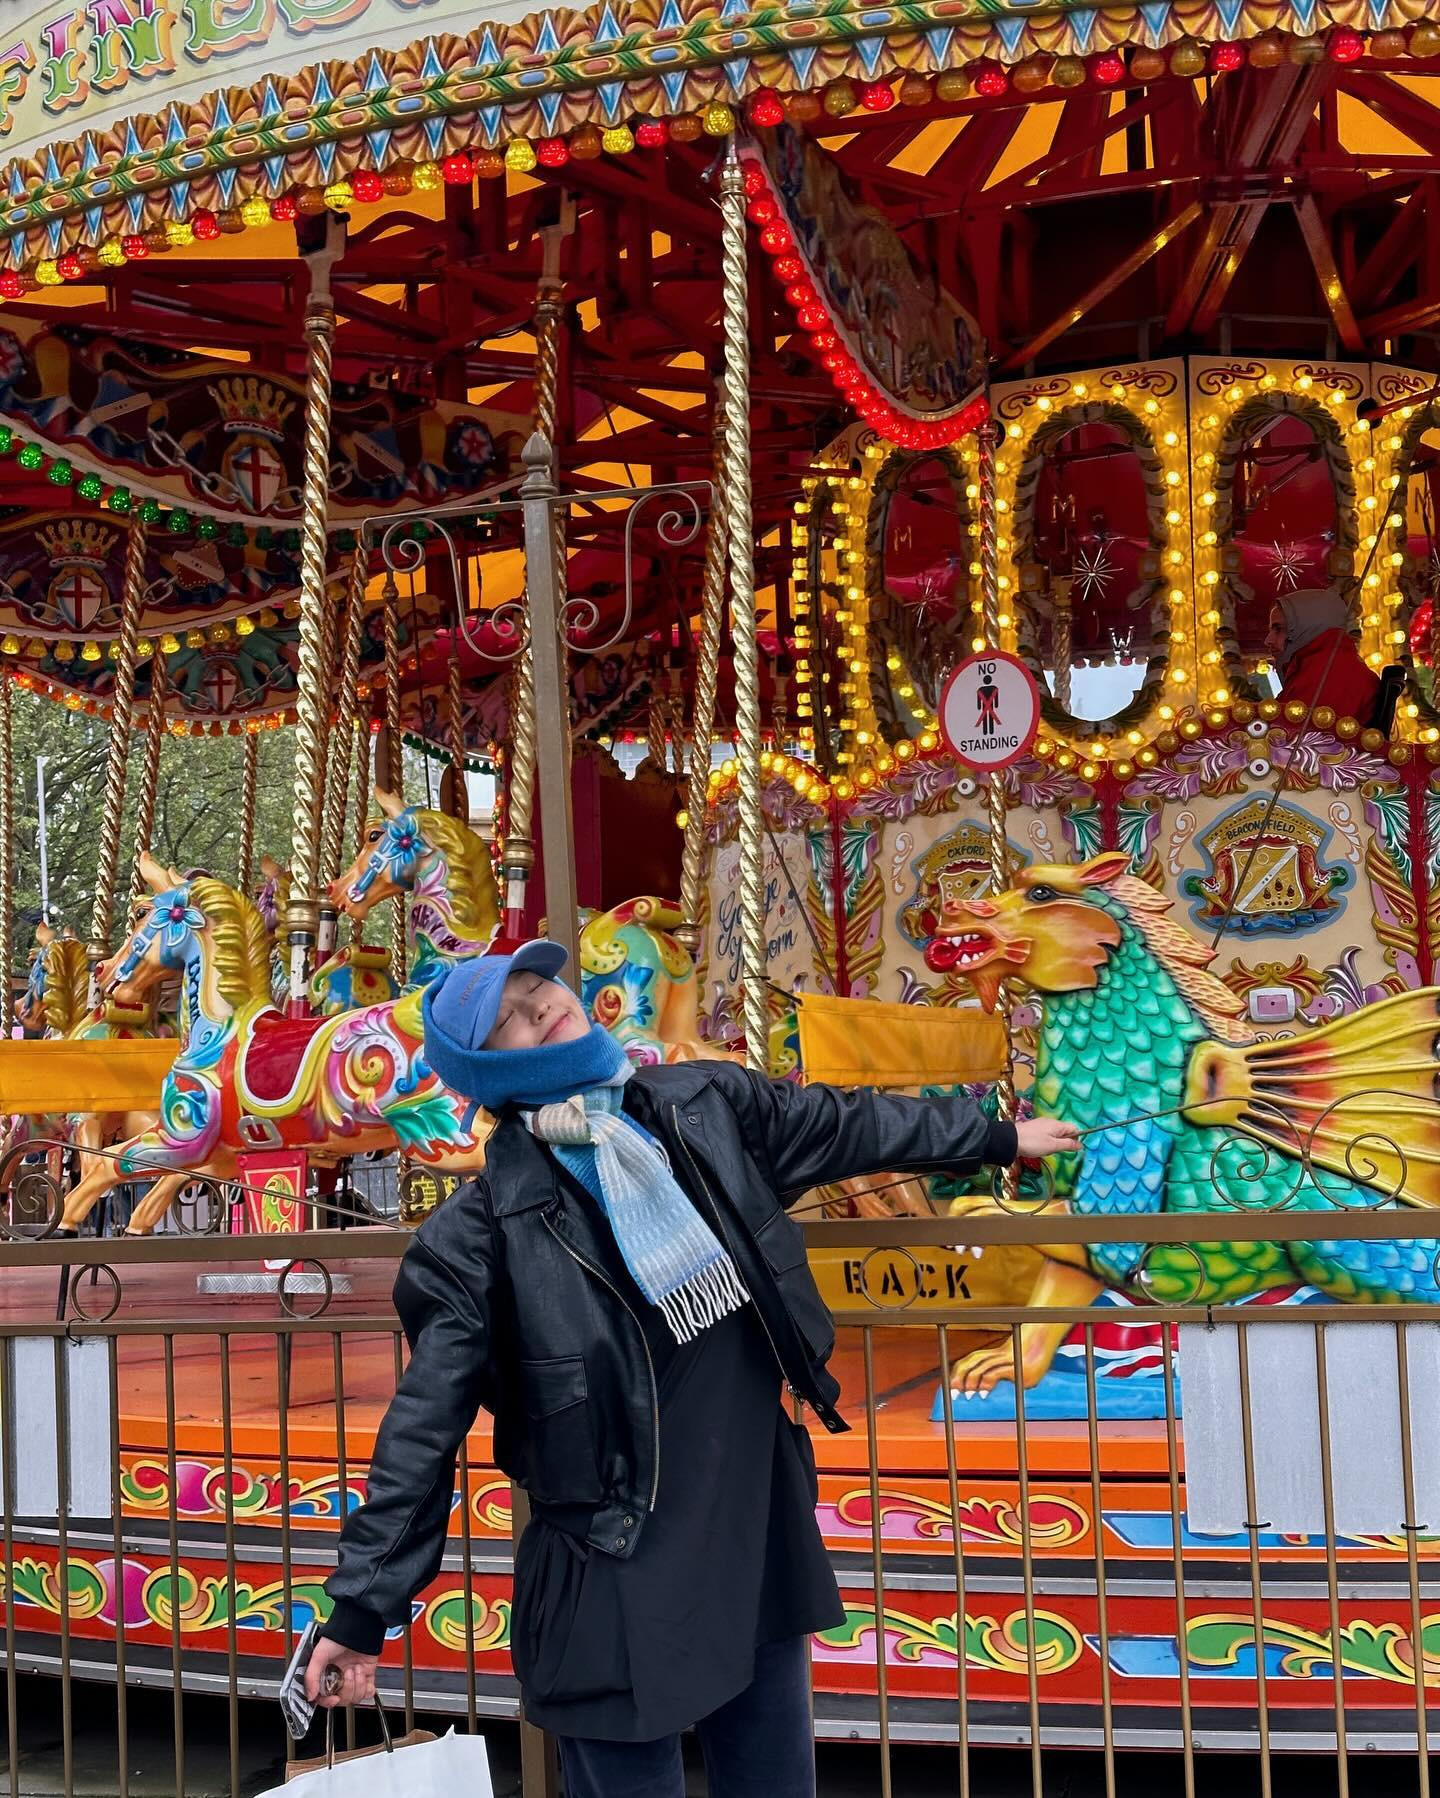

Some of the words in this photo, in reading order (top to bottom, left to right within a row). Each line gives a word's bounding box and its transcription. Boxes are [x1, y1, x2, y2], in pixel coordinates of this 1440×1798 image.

[978, 662, 997, 676] NO
[960, 735, 1019, 753] STANDING
[947, 844, 986, 859] OXFORD
[843, 1260, 972, 1299] BACK
